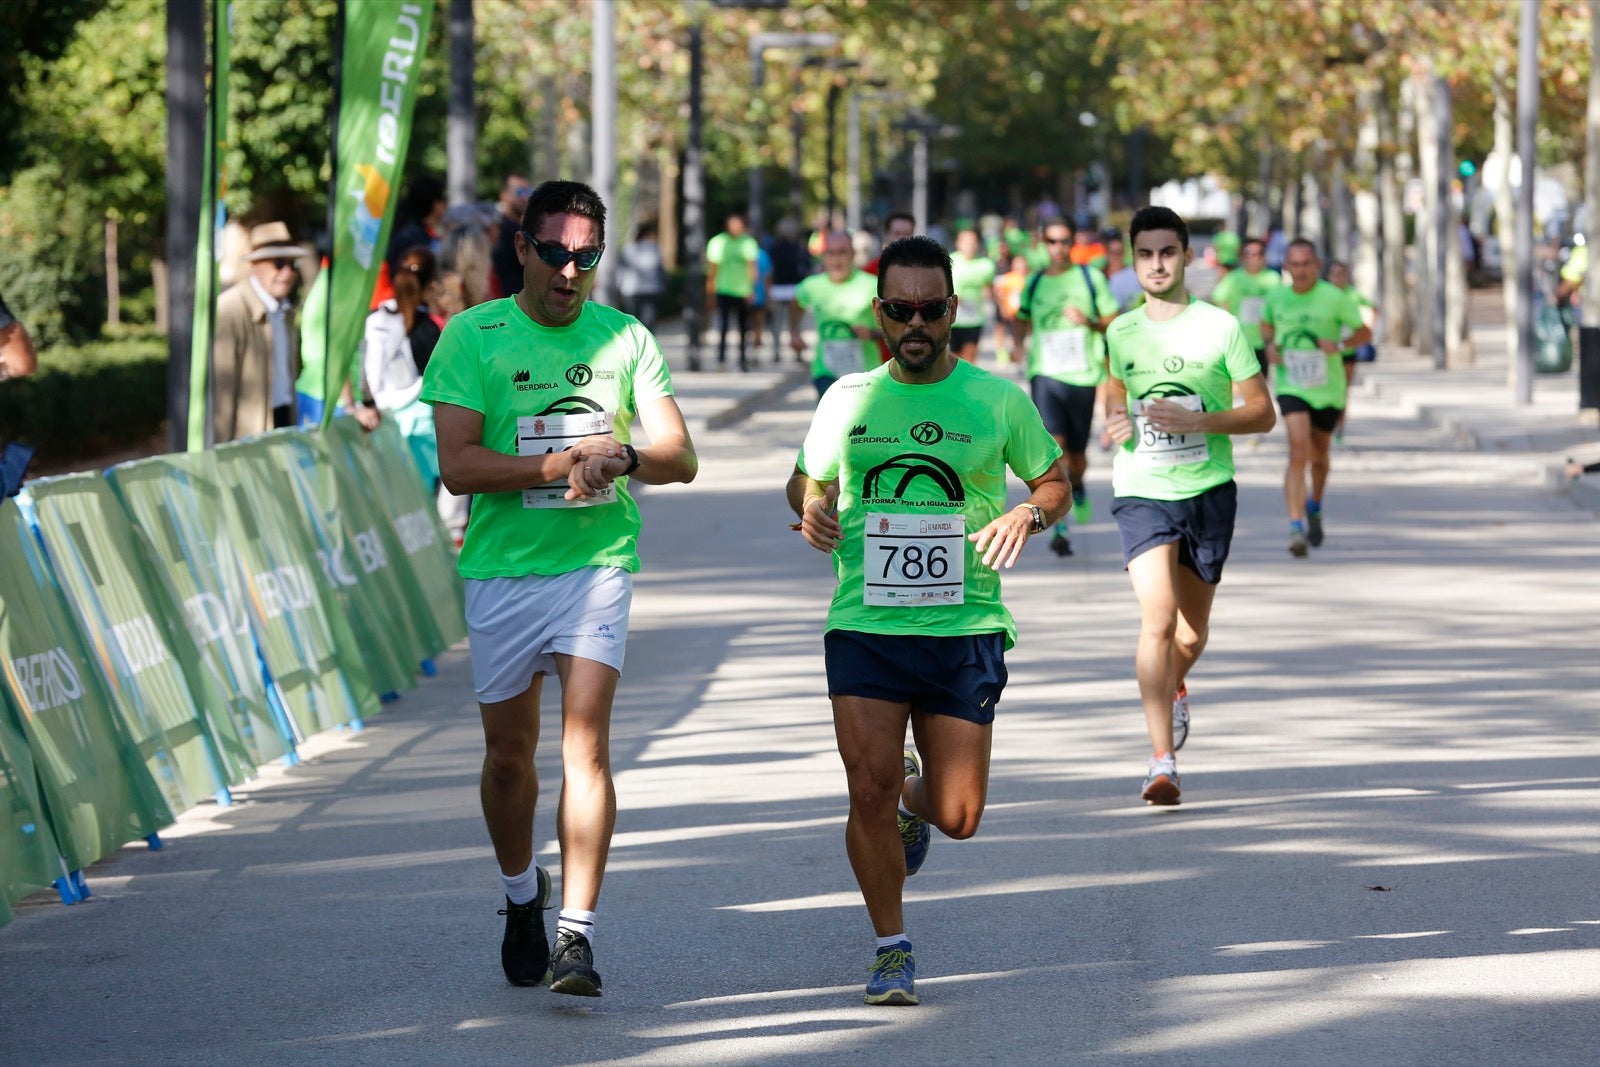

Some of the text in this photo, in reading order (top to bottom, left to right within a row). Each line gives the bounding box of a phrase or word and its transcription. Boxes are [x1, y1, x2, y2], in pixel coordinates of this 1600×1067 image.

[516, 382, 559, 391] IBERDROLA
[850, 436, 900, 445] IBERDROLA
[879, 545, 948, 580] 786
